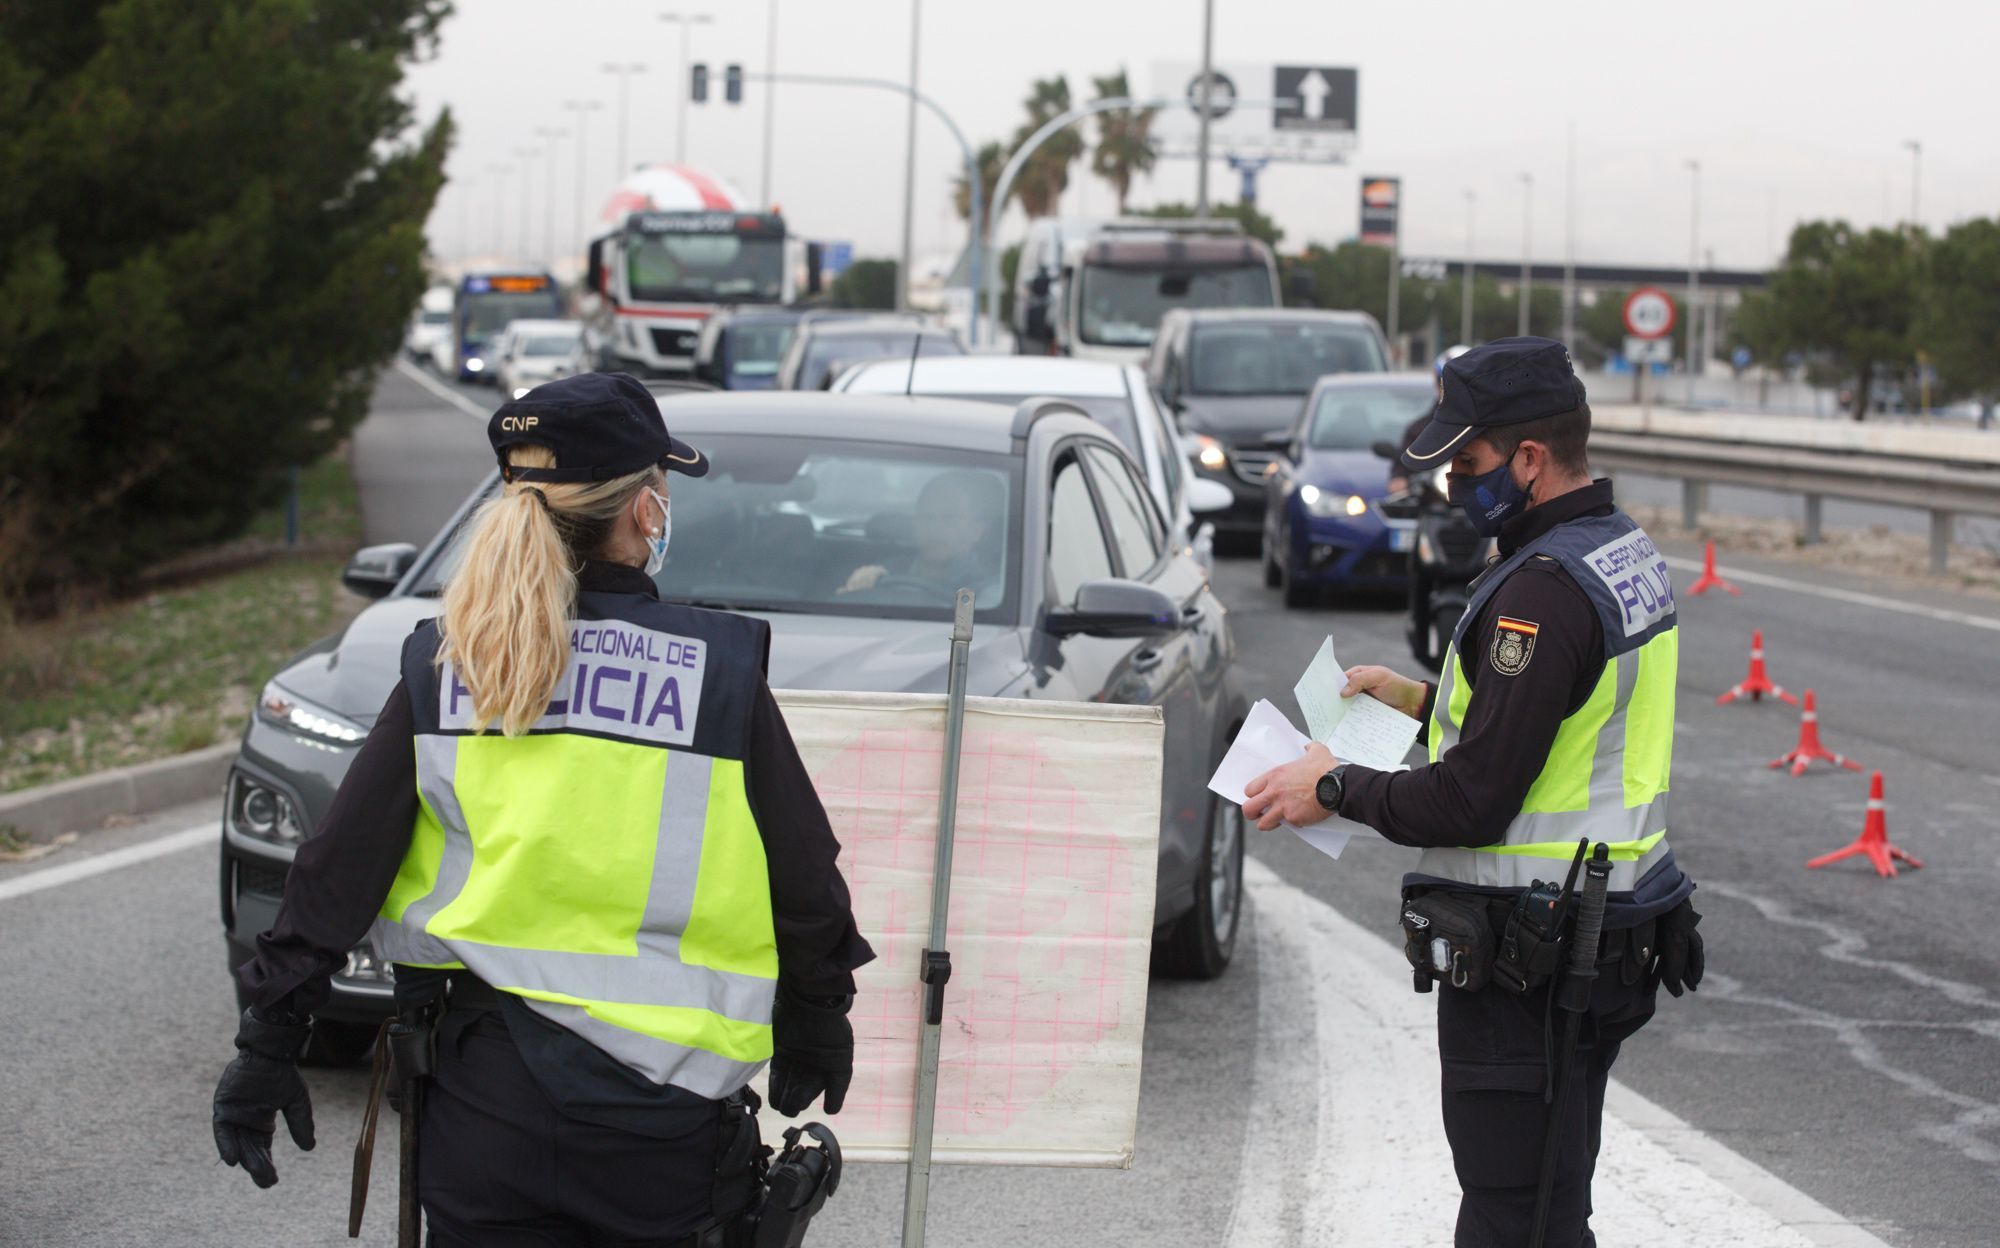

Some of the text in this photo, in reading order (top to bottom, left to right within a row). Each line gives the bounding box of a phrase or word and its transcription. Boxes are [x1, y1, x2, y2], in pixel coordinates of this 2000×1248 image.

[501, 416, 539, 432] CNP
[570, 629, 697, 669] ACIONAL DE
